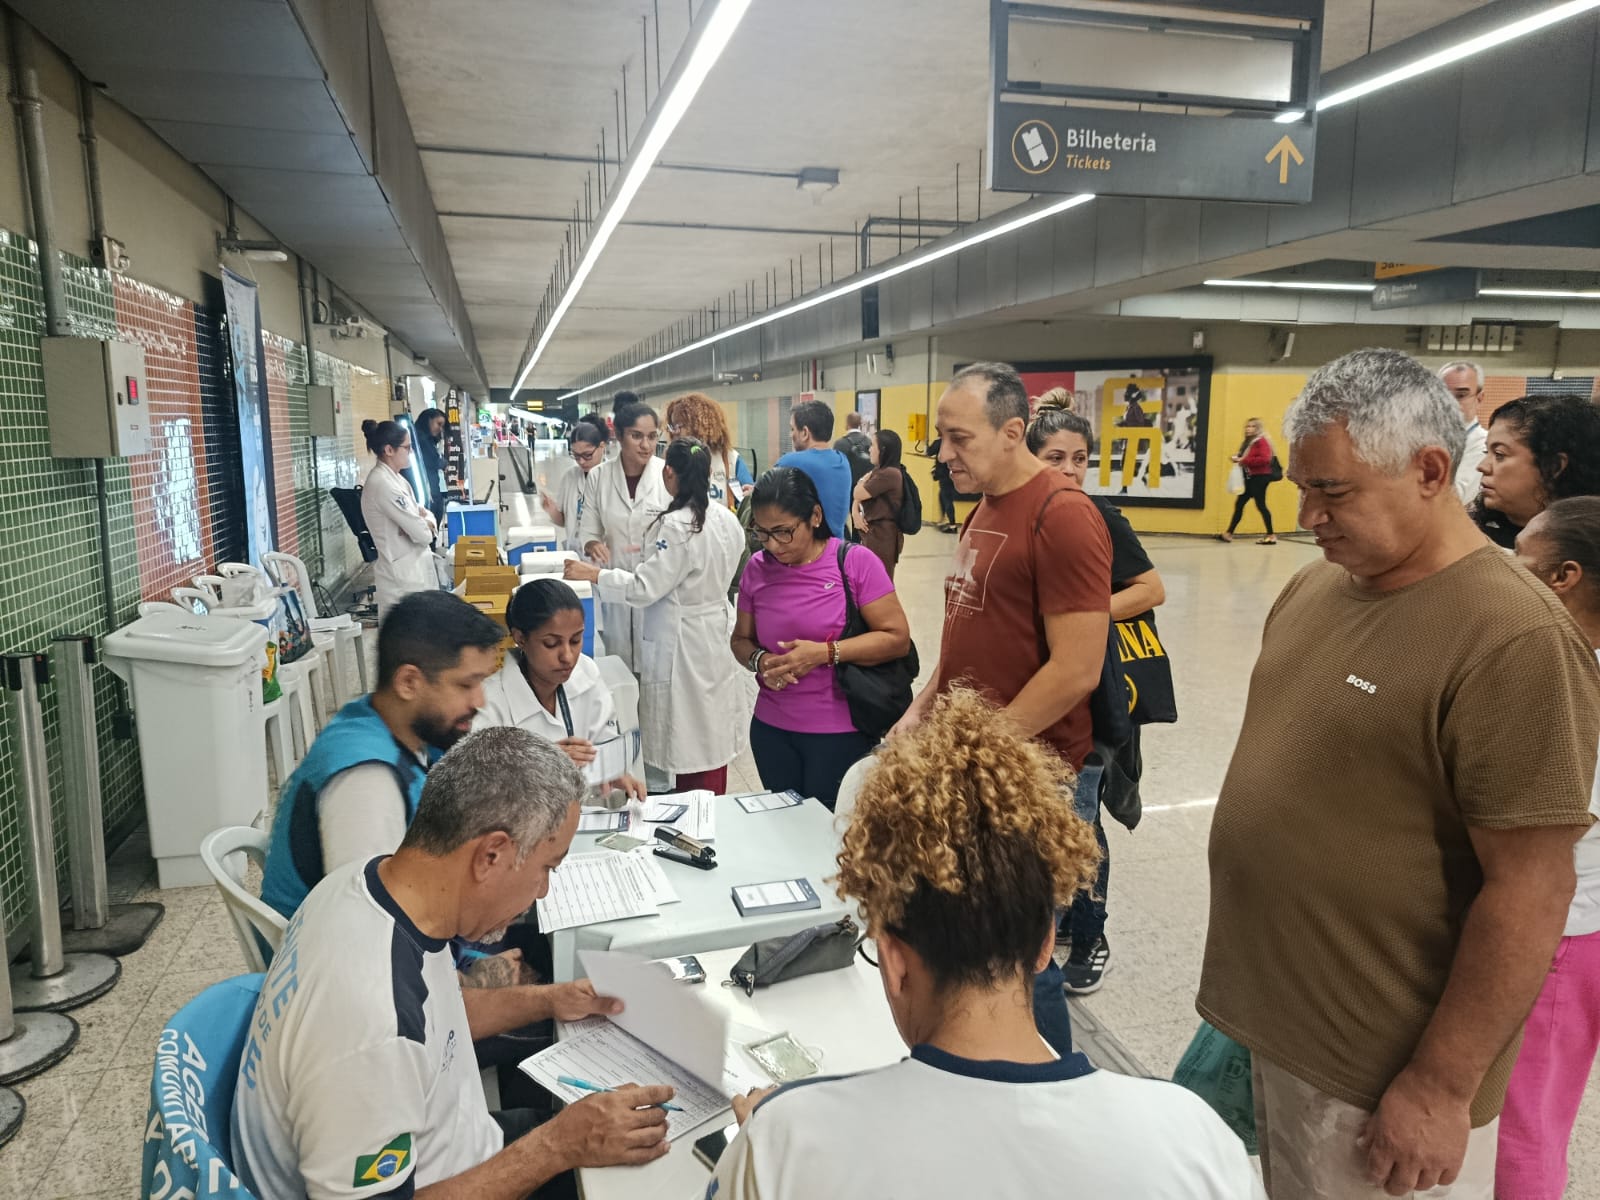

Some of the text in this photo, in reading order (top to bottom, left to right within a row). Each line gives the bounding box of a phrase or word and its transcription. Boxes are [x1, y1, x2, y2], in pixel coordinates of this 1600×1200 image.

[1066, 128, 1157, 153] Bilheteria
[1066, 155, 1111, 170] Tickets
[1346, 674, 1377, 694] BOSS
